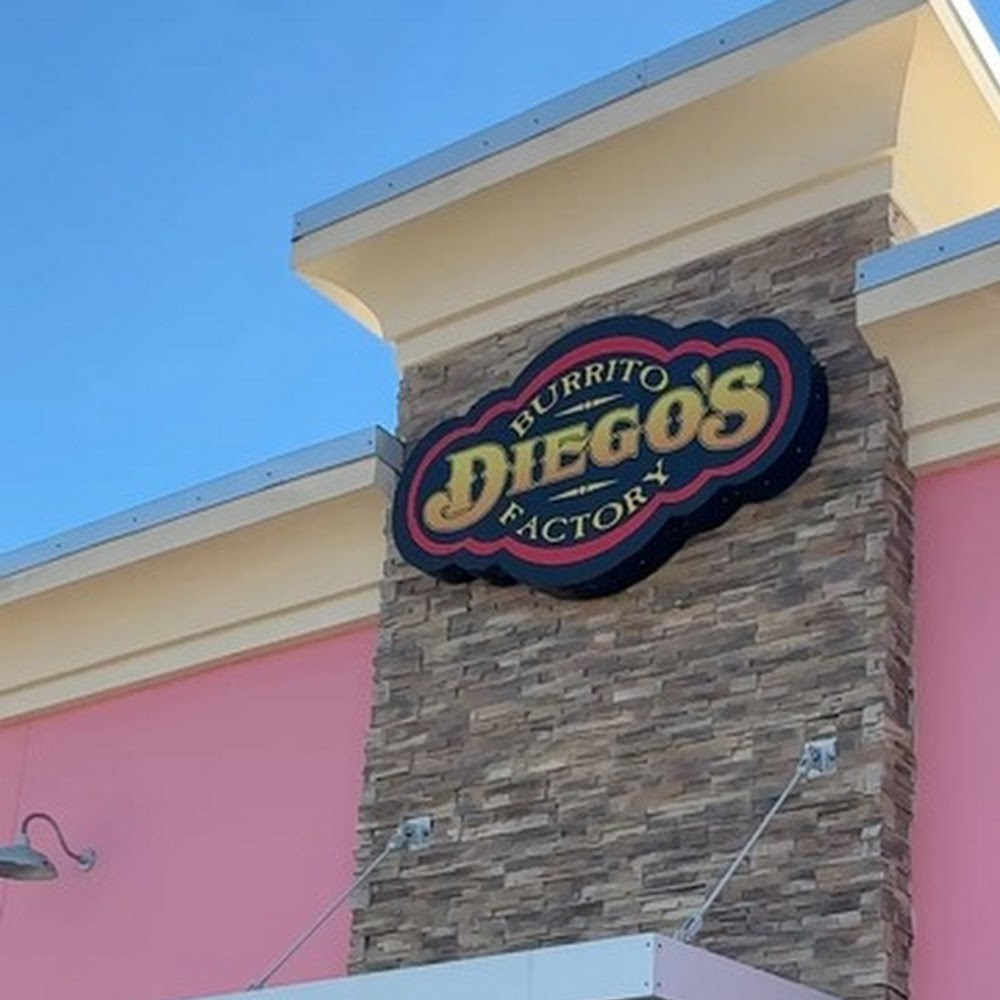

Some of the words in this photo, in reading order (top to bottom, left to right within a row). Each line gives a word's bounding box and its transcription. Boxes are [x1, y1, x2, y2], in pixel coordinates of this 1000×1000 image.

[509, 358, 669, 438] BURRITO
[423, 363, 770, 533] DIEGO'S
[499, 459, 670, 543] FACTORY
